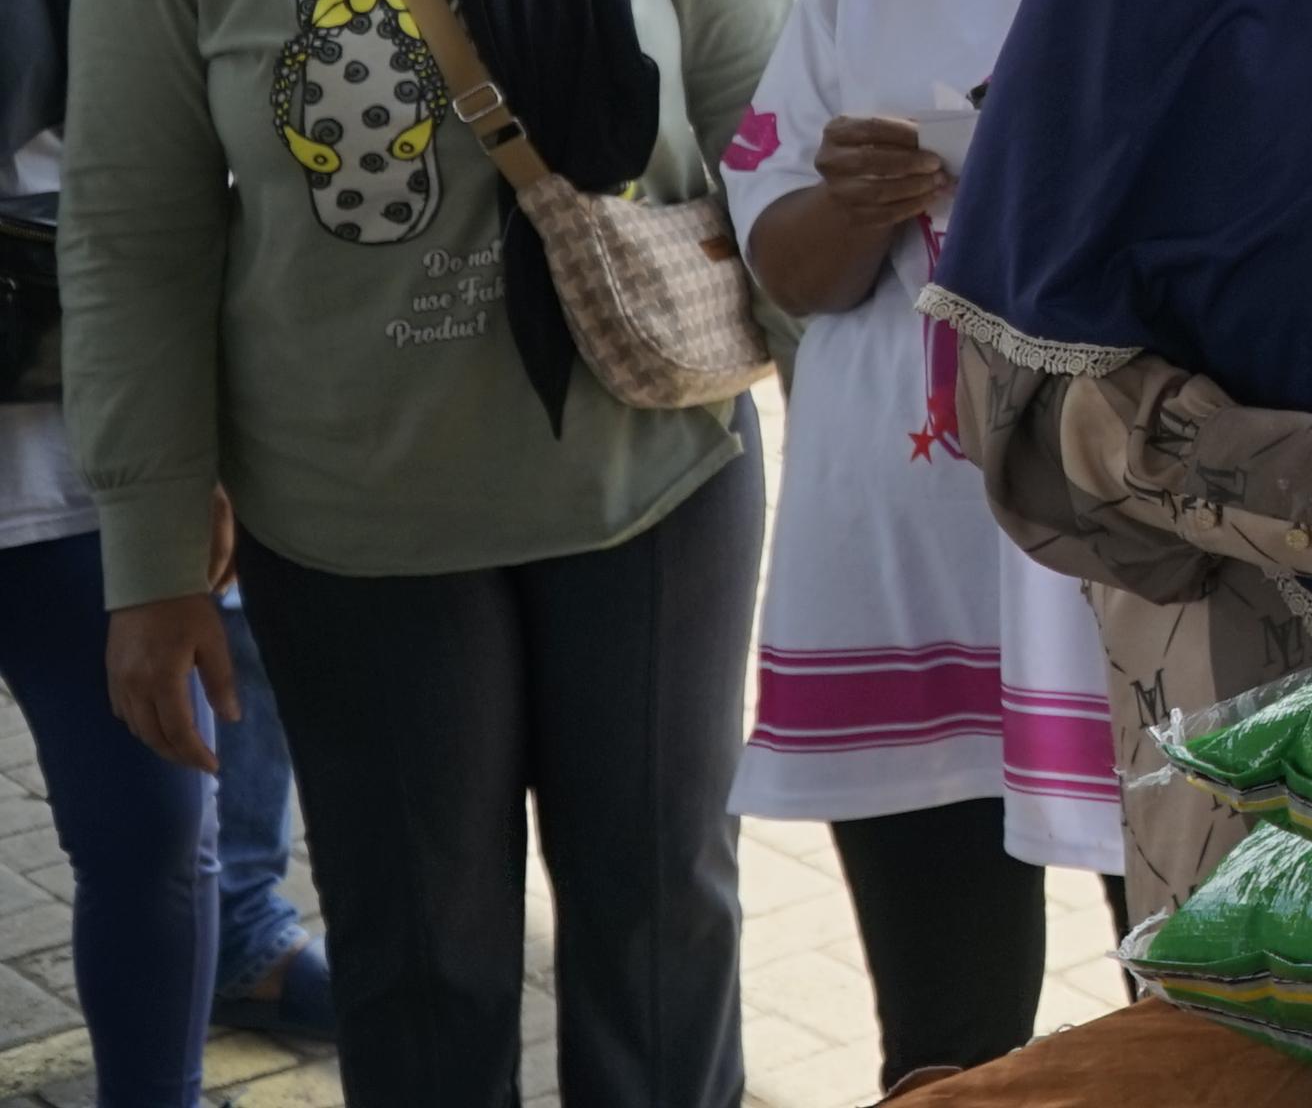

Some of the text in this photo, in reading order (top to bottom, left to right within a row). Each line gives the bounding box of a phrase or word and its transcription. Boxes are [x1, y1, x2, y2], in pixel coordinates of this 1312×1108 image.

[423, 240, 502, 277] Do not
[413, 276, 505, 312] use Fak
[385, 311, 487, 348] Product
